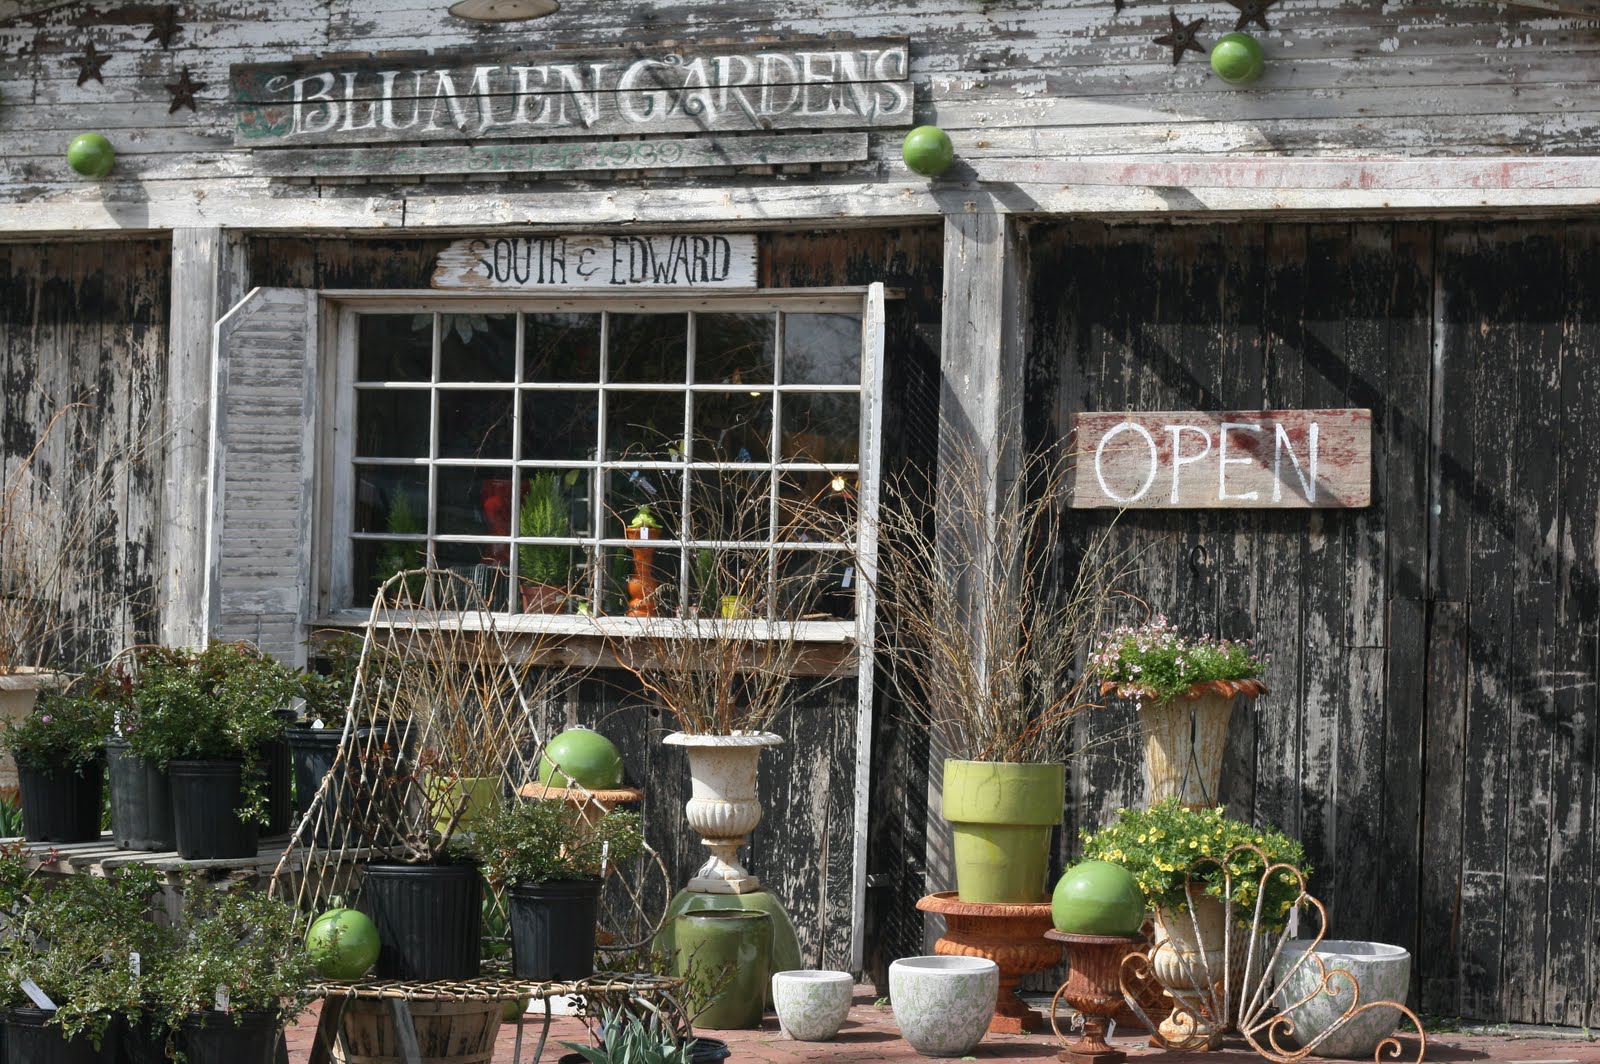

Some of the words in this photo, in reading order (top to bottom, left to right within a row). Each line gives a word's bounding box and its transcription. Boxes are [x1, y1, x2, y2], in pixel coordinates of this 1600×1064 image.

[265, 64, 612, 139] BLUMEN
[618, 46, 908, 131] GARDENS
[466, 145, 583, 170] SINCE
[595, 142, 684, 167] 1989
[470, 236, 568, 284] SOUTH
[576, 248, 600, 276] &
[609, 235, 731, 285] EDWARD
[1094, 421, 1319, 504] OPEN
